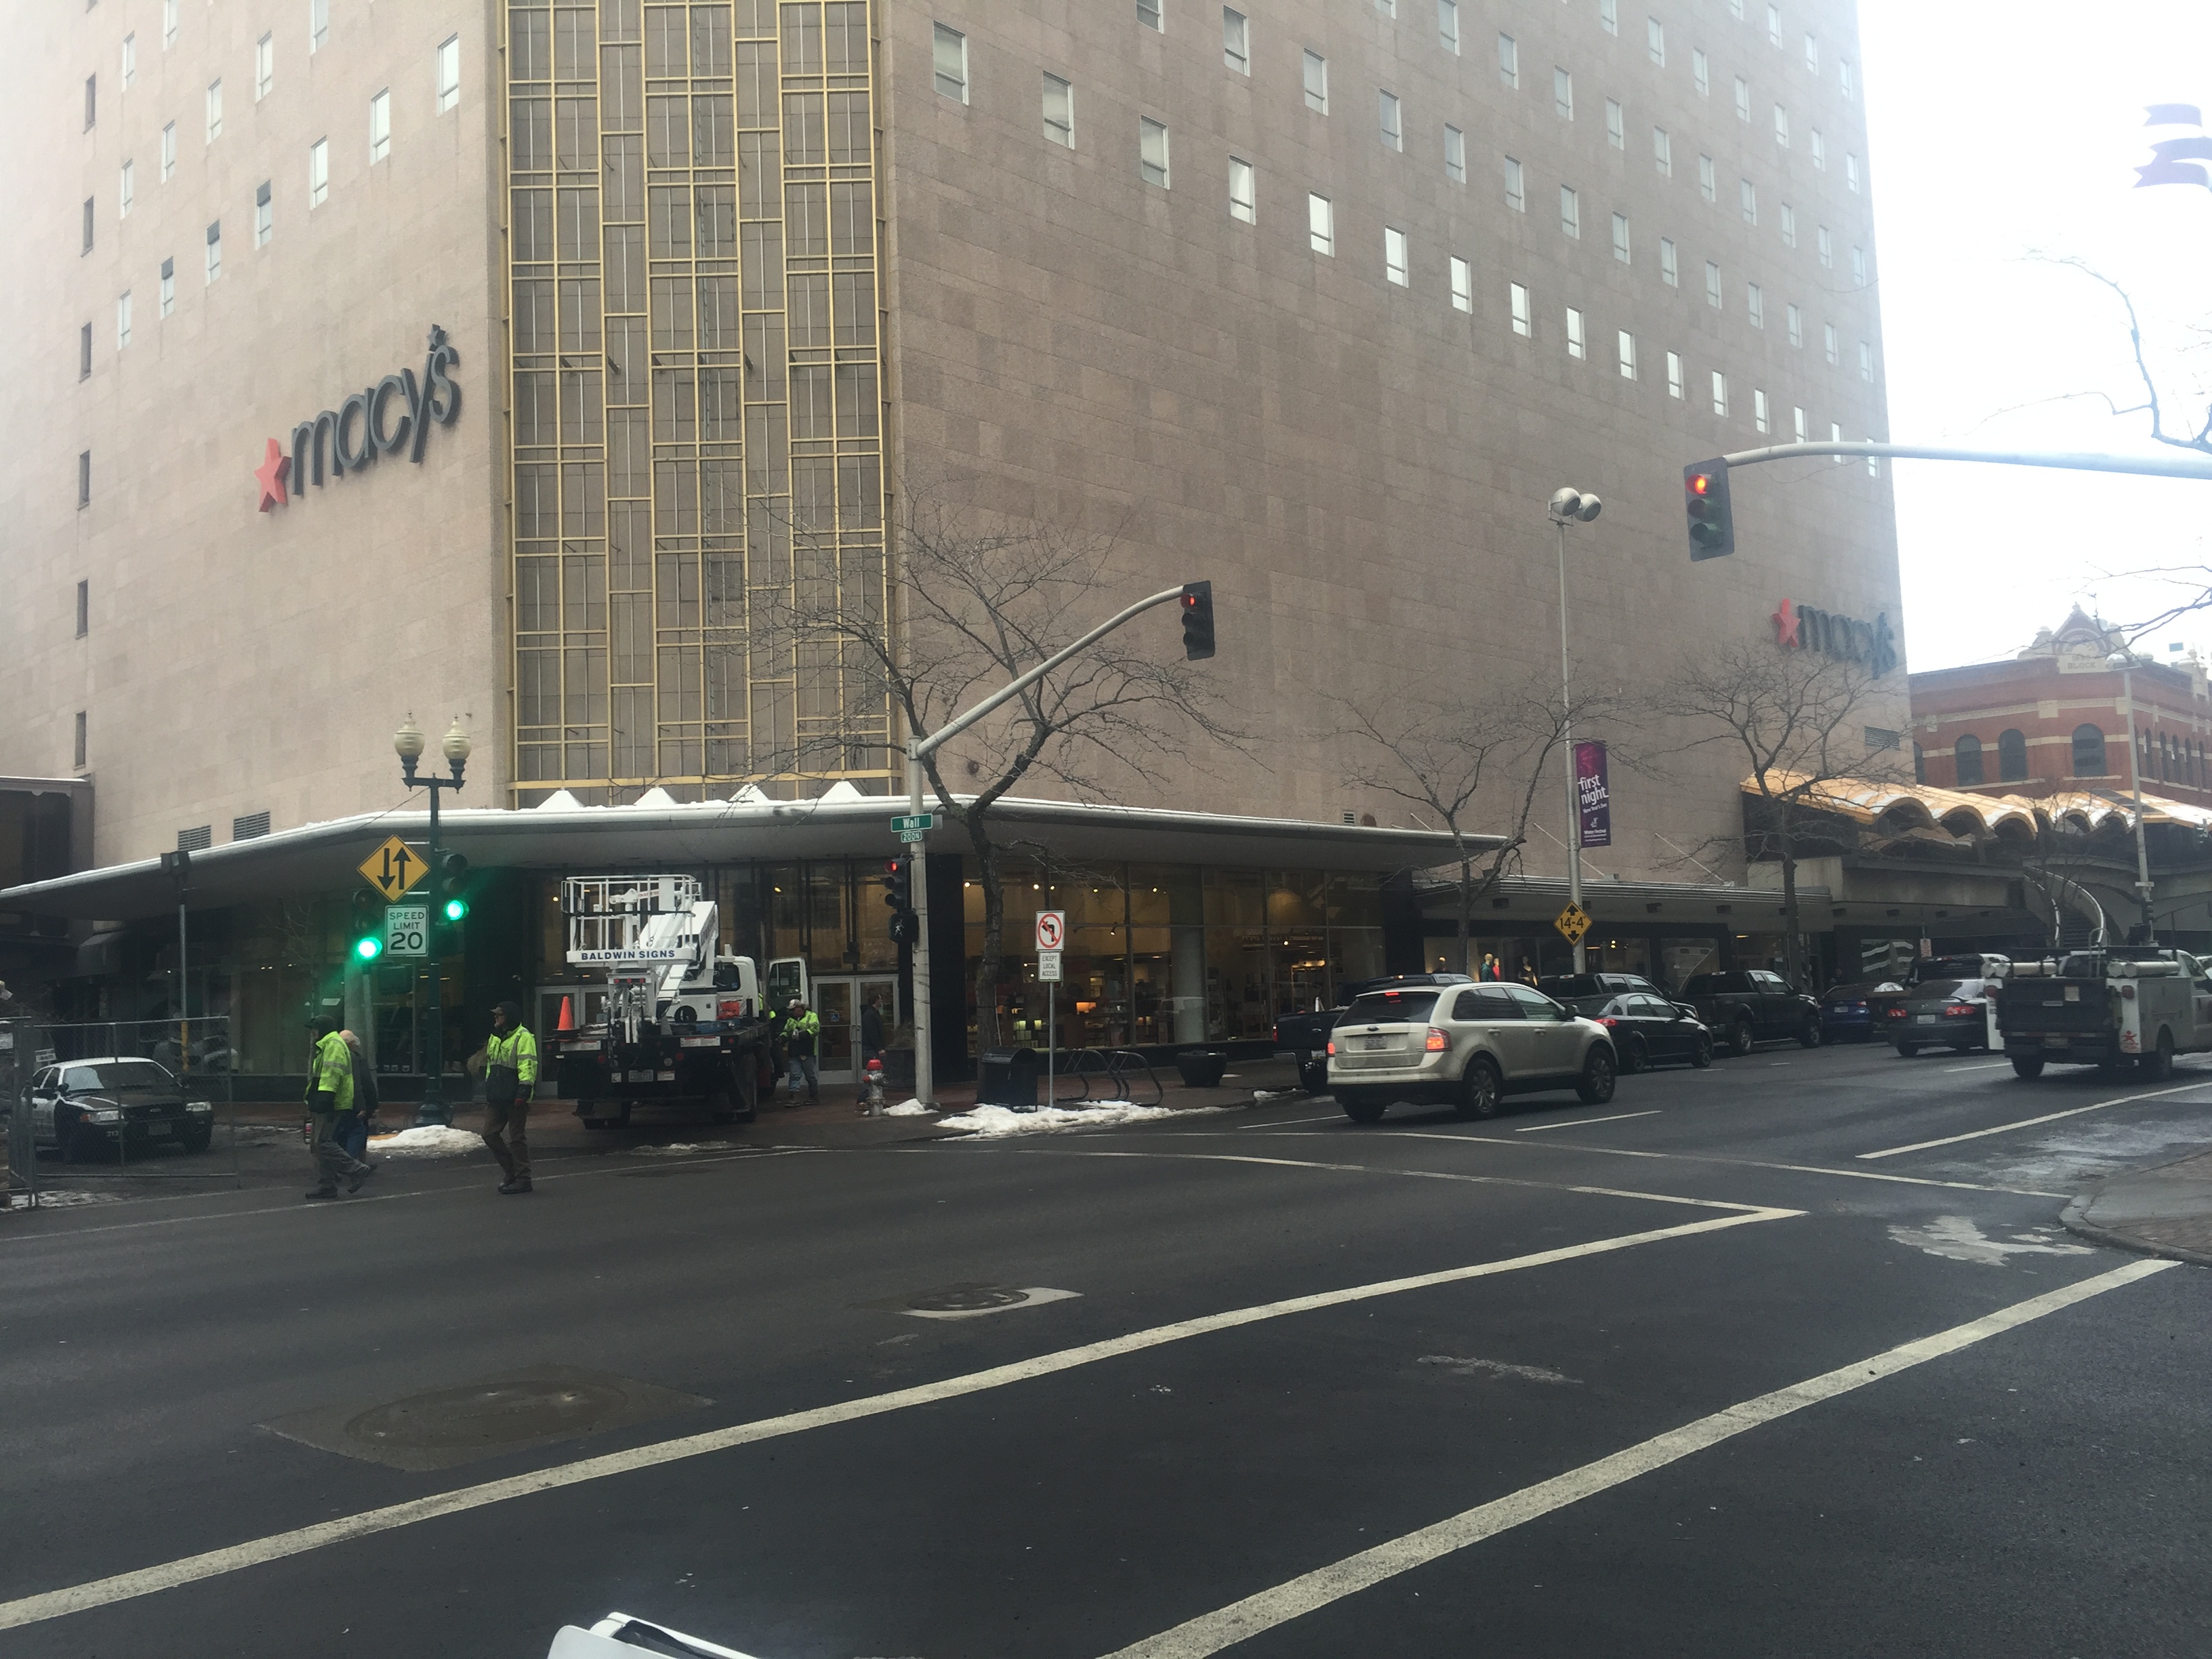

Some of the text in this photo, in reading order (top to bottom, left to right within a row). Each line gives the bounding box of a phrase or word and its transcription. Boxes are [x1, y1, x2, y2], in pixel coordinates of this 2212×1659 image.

[291, 324, 462, 496] macy's
[1578, 775, 1601, 791] first
[1581, 787, 1609, 805] night
[903, 817, 920, 829] Wall
[394, 922, 420, 930] LIMIT
[390, 932, 423, 950] 20
[581, 950, 675, 960] BALDWIN SIGNS
